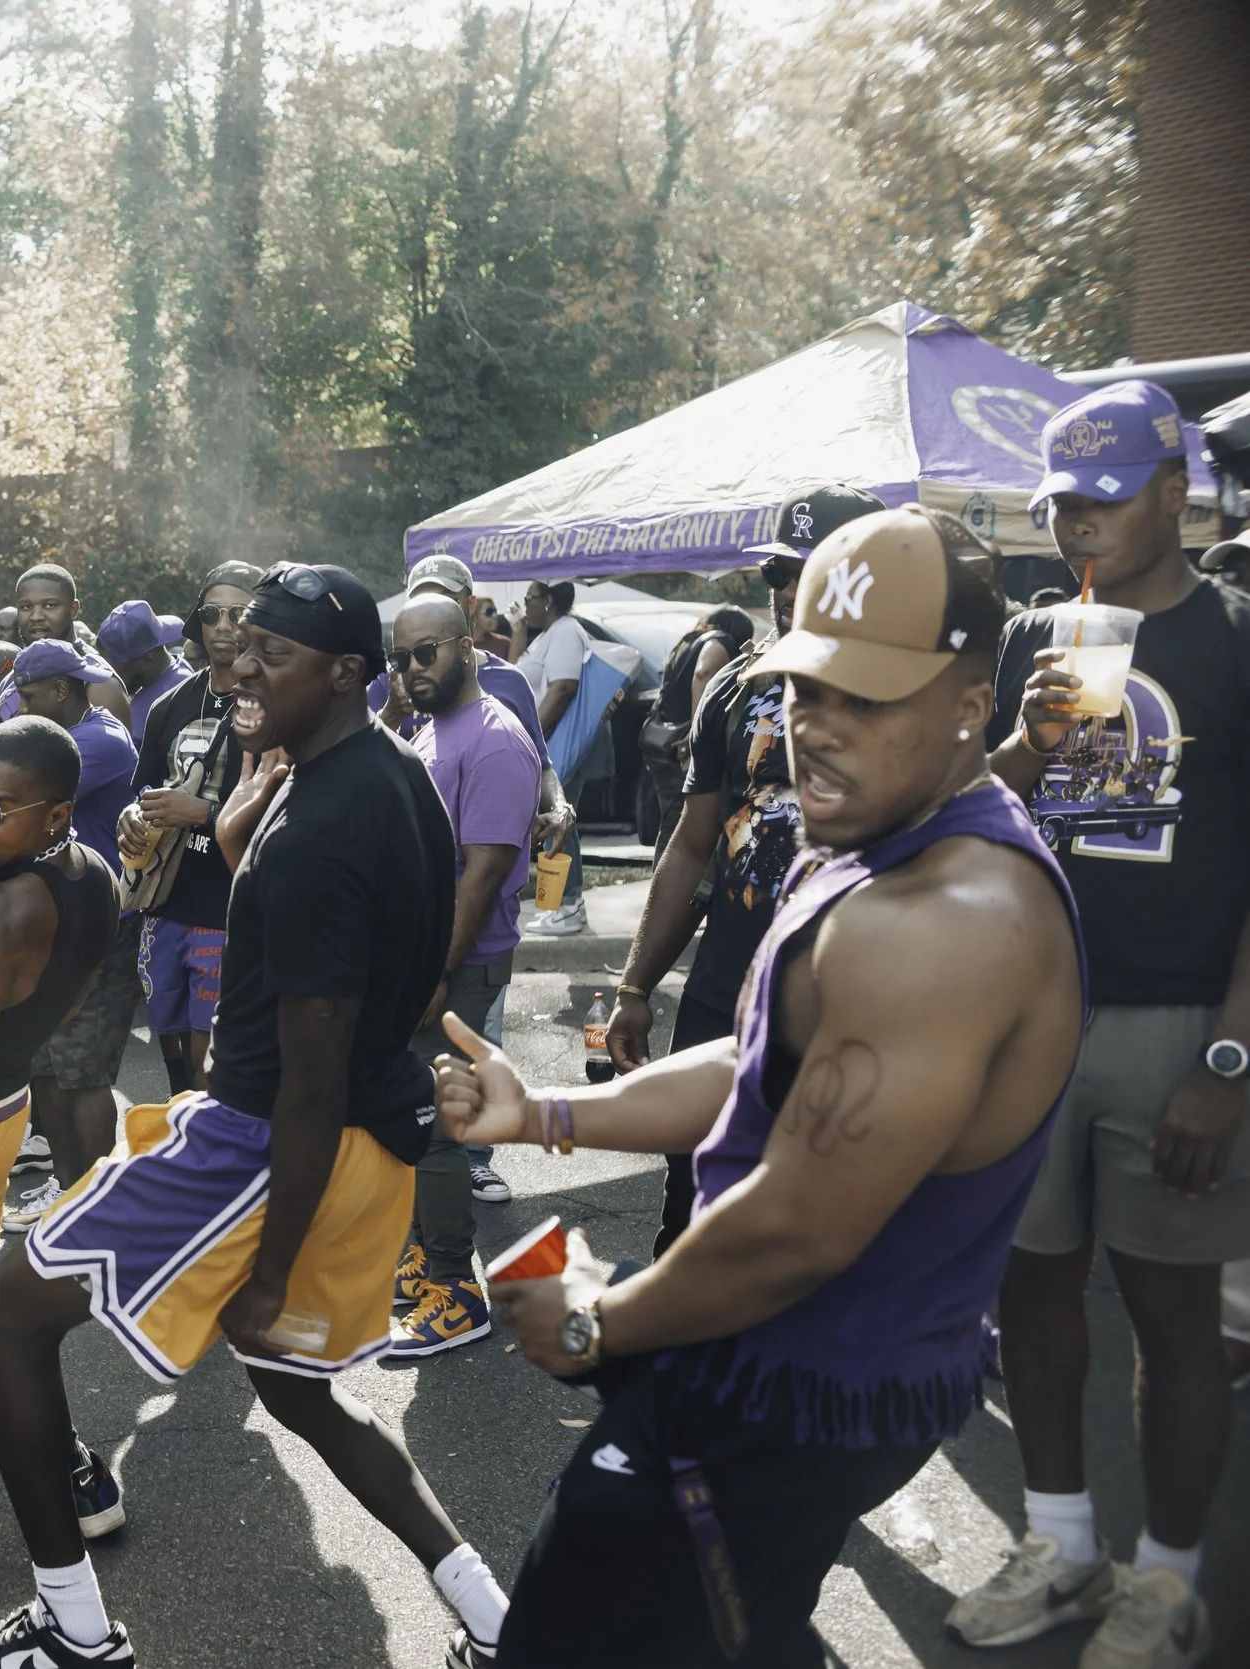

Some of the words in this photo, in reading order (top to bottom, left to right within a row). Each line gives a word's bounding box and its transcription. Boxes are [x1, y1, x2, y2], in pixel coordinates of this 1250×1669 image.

[471, 532, 536, 564] OMEGA
[535, 527, 571, 559] PSI
[570, 525, 611, 557] PHI
[608, 510, 747, 552] FRATERNITY,
[816, 558, 875, 621] NY
[193, 833, 212, 854] APE
